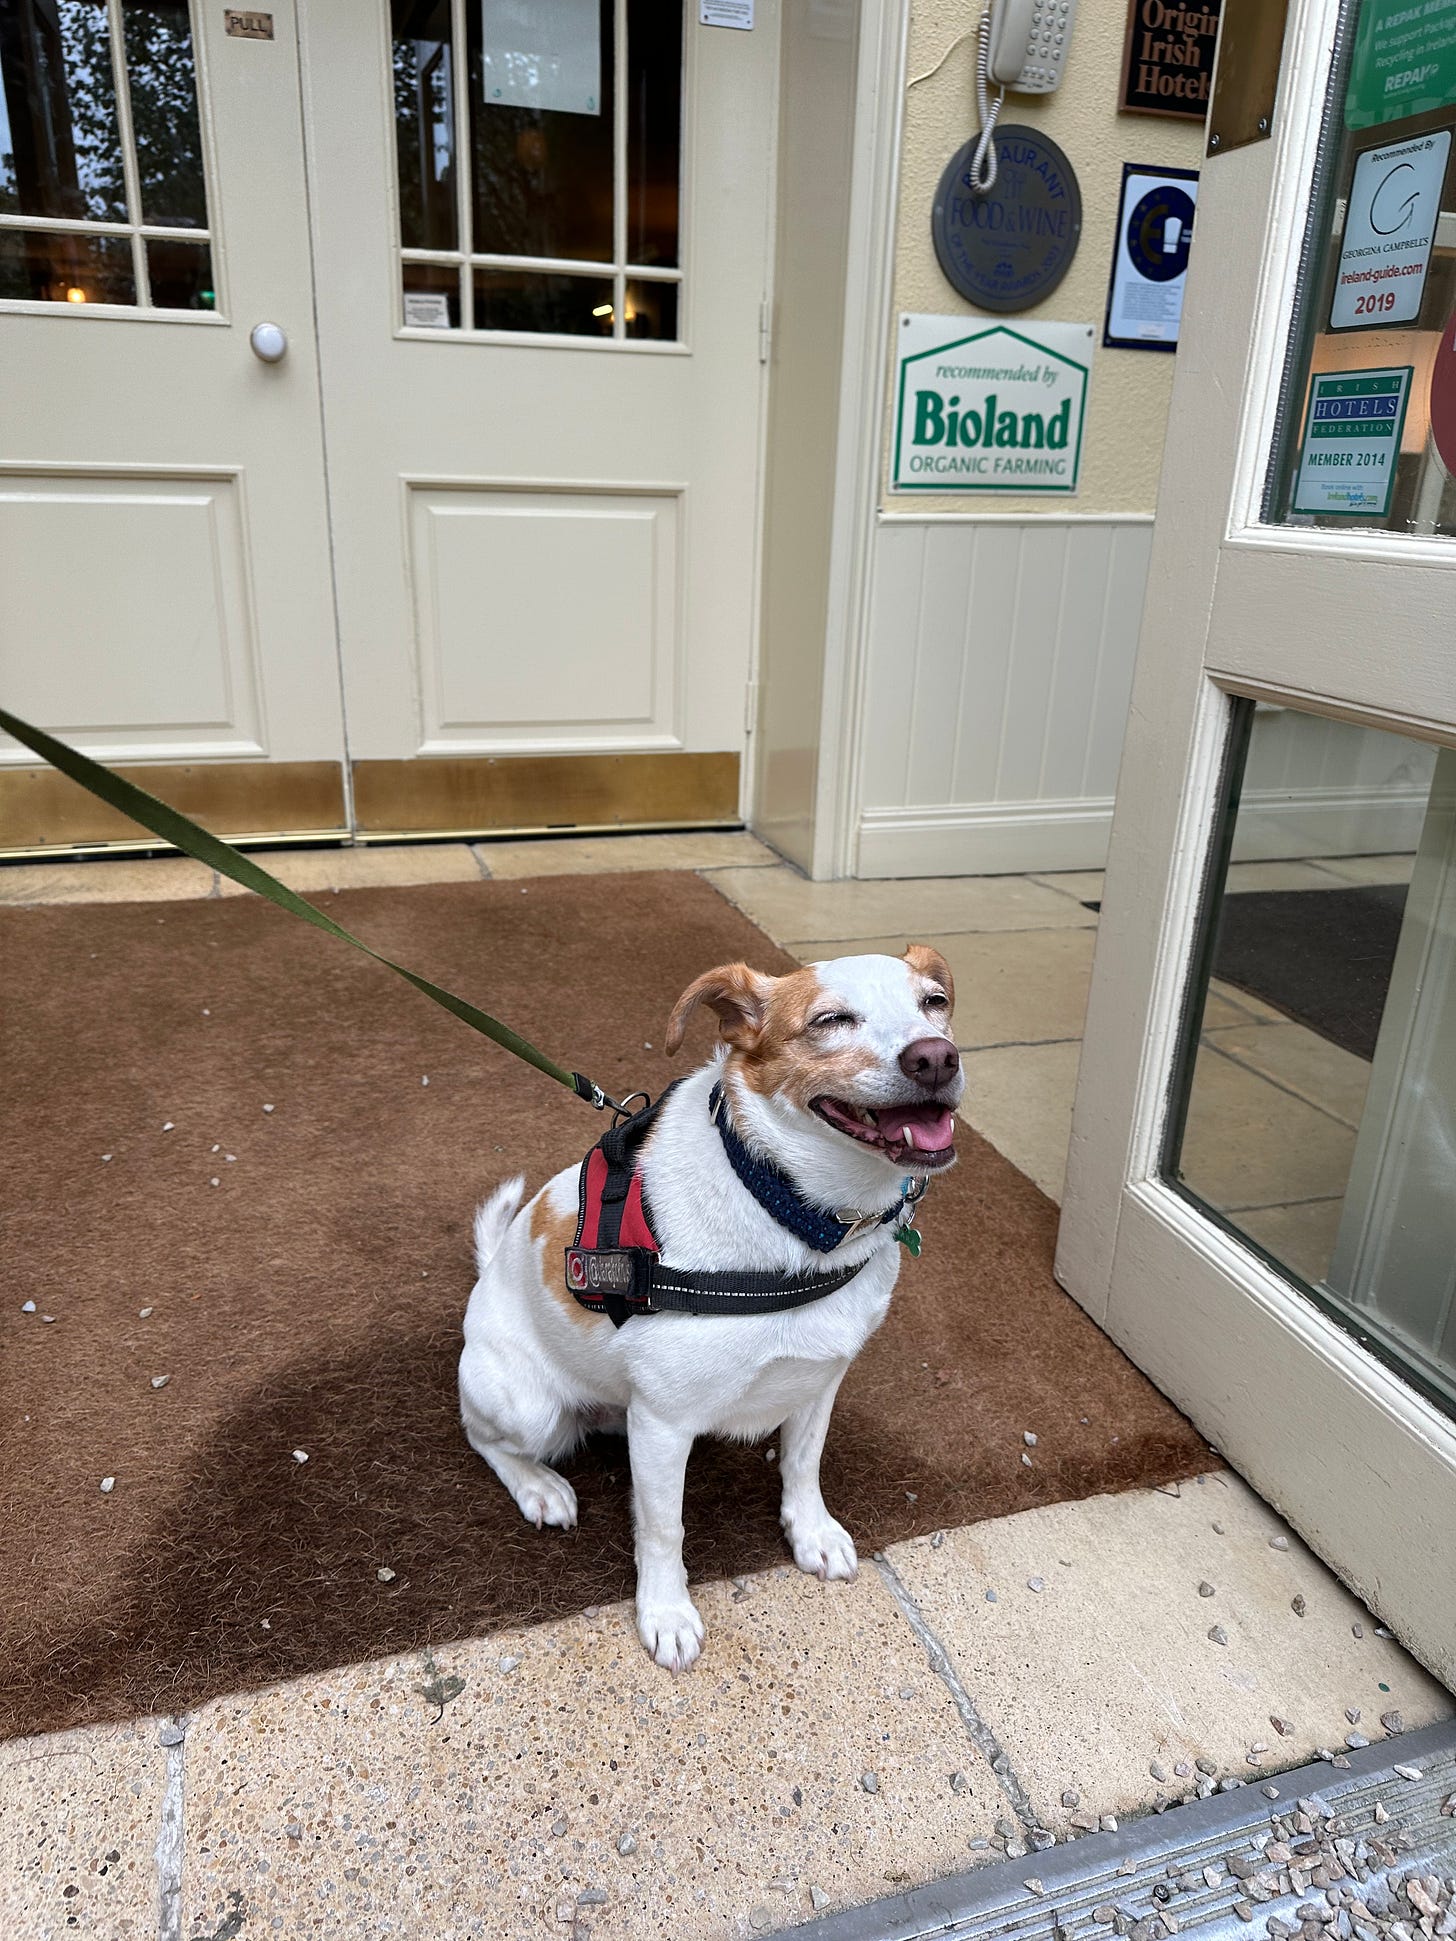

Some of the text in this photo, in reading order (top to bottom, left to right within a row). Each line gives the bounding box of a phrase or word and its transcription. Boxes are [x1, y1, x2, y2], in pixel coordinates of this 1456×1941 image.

[230, 16, 267, 33] PULL
[1375, 19, 1383, 33] A
[1384, 5, 1422, 29] REPAK
[1388, 28, 1423, 48] support
[1139, 31, 1201, 68] Irish
[1376, 48, 1415, 68] Recycling
[1416, 45, 1425, 55] in
[1372, 140, 1436, 163] Recommended By
[951, 197, 1004, 231] FOOD
[1018, 205, 1068, 239] WINE
[1342, 246, 1381, 260] GEORGINA
[1341, 263, 1423, 285] ireland-guide.com
[1354, 292, 1396, 315] 2019
[936, 364, 1059, 388] recommended by
[1320, 381, 1400, 394] IRISH
[1316, 399, 1396, 417] HOTELS
[912, 389, 1071, 450] Bioland
[1313, 423, 1393, 434] FEDERATION
[909, 455, 1066, 476] ORGANIC FARMING
[1308, 452, 1386, 466] MEMBER 2014
